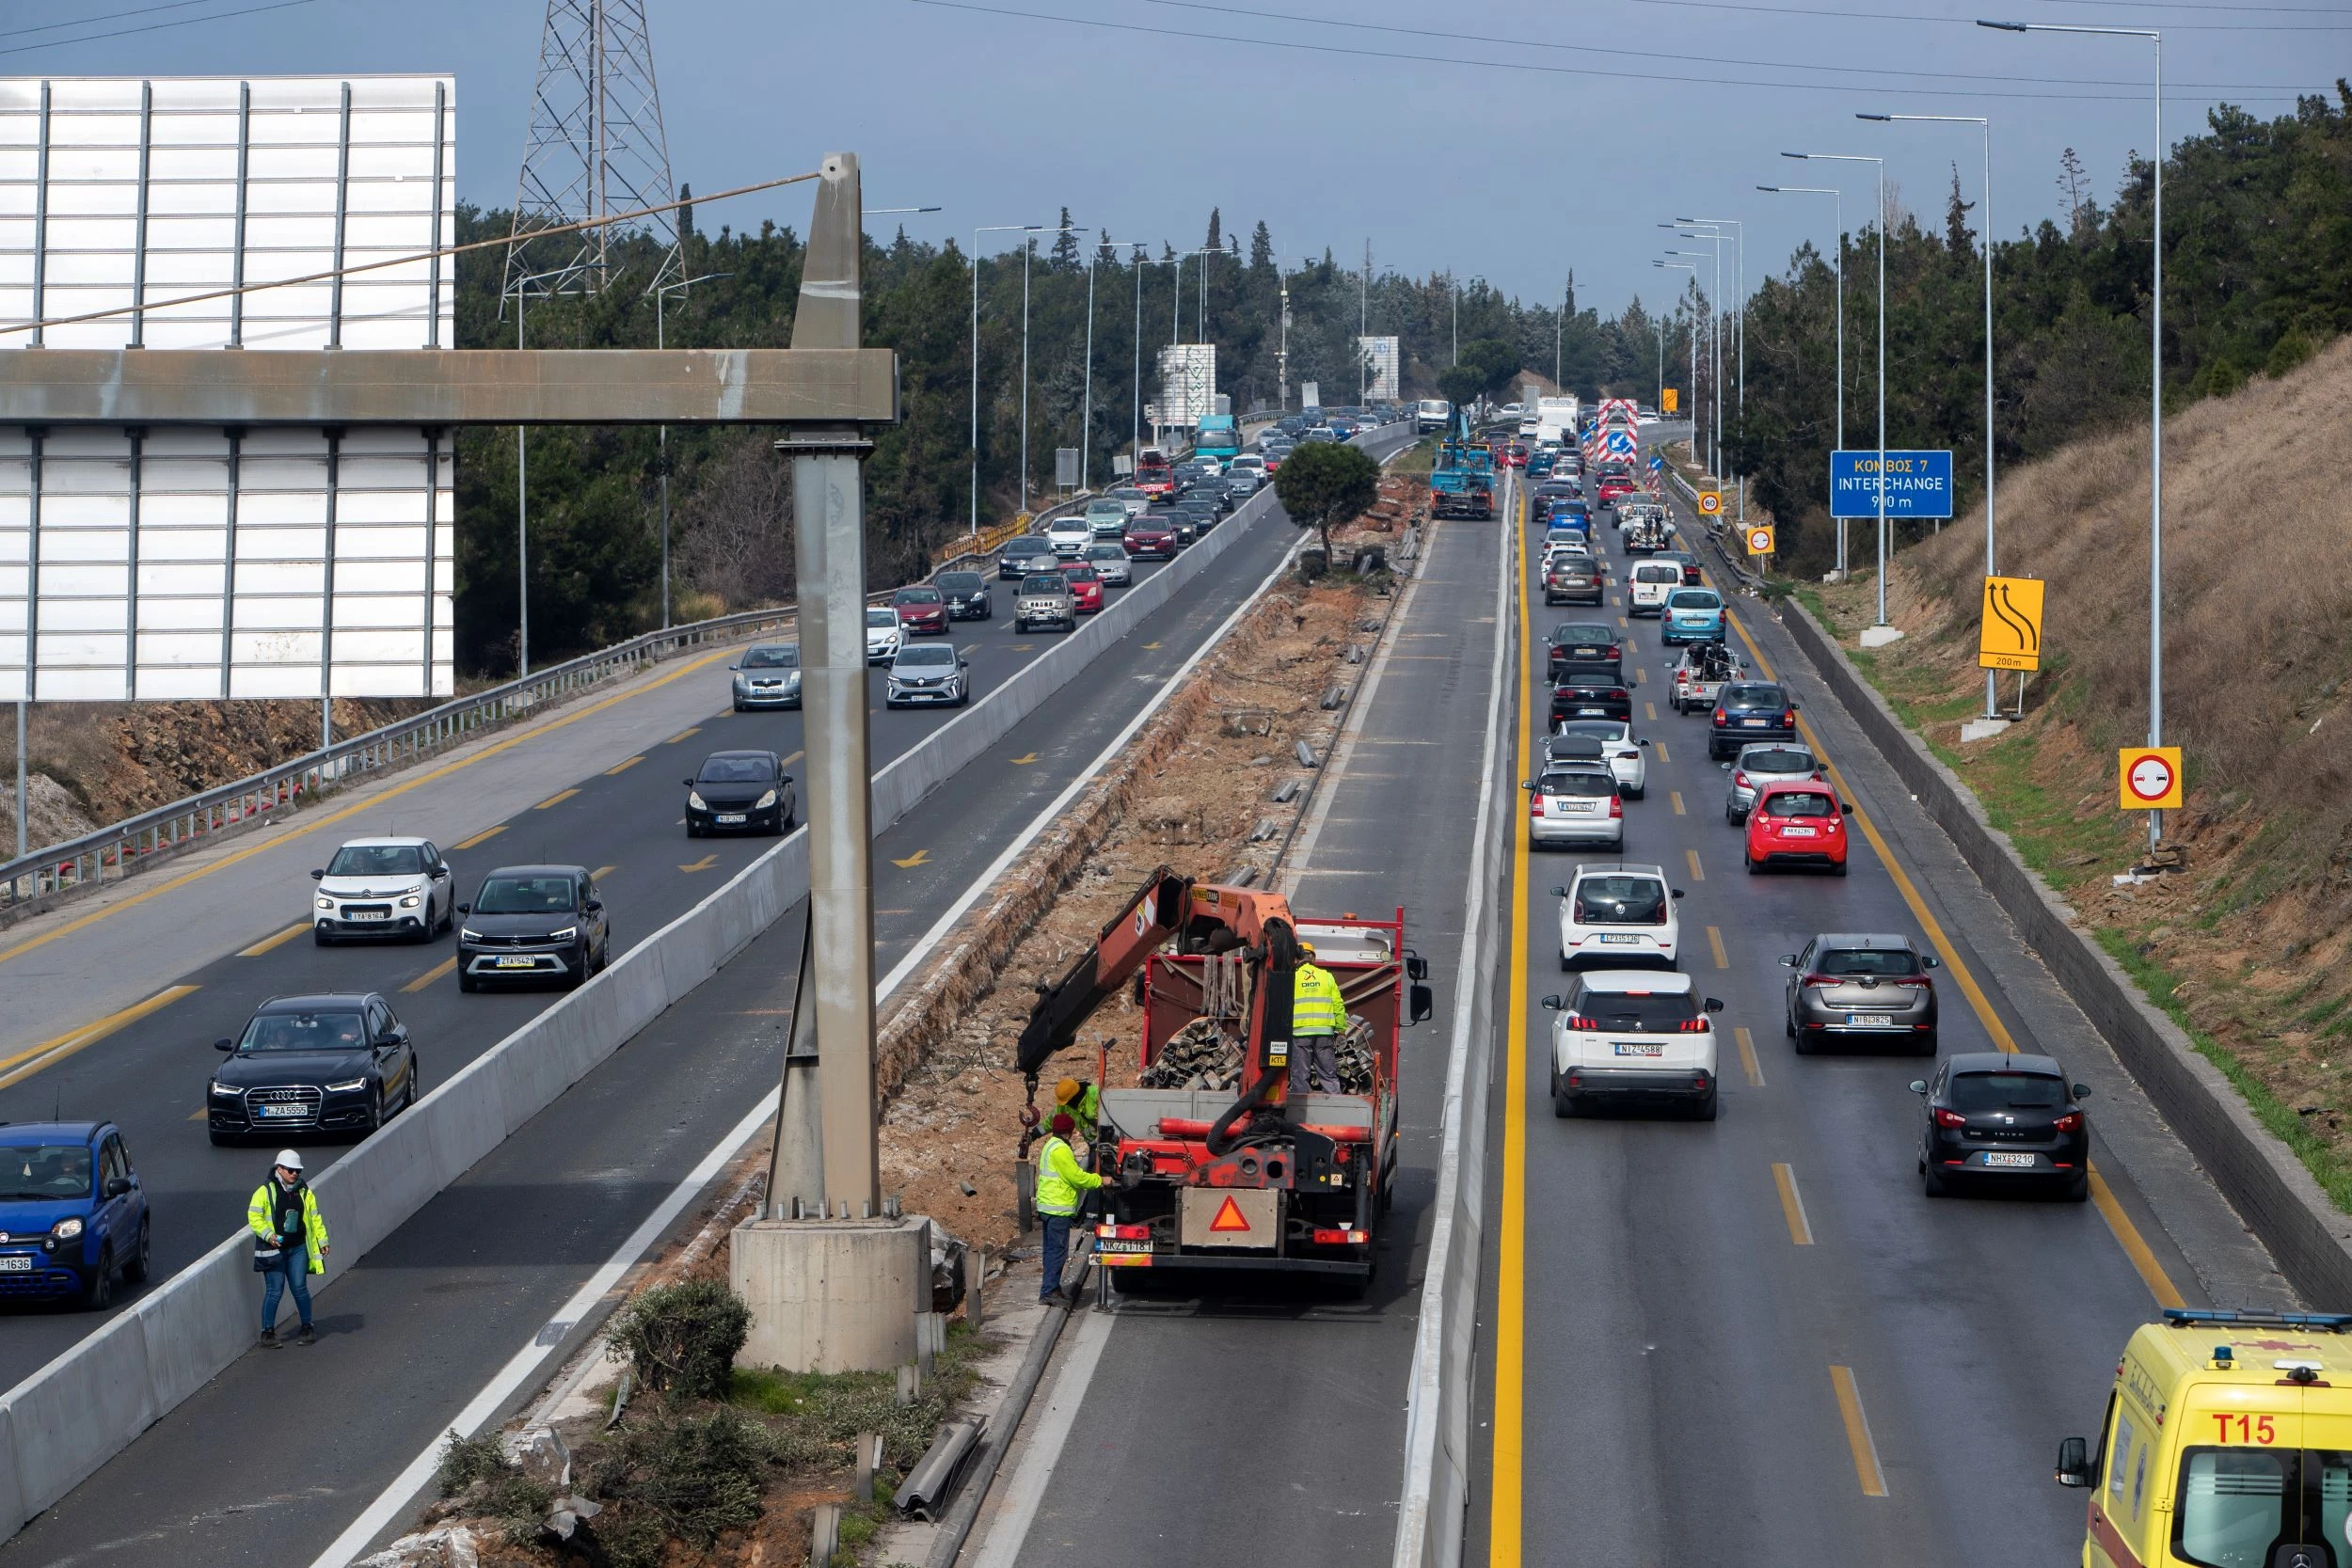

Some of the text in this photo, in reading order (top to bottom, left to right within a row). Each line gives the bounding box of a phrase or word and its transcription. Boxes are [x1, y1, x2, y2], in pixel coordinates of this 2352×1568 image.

[1920, 460, 1928, 472] 7
[1839, 477, 1944, 490] INTERCHANGE
[1871, 496, 1912, 508] 90 m
[1271, 1056, 1285, 1065] KTL
[2213, 1414, 2275, 1445] T15
